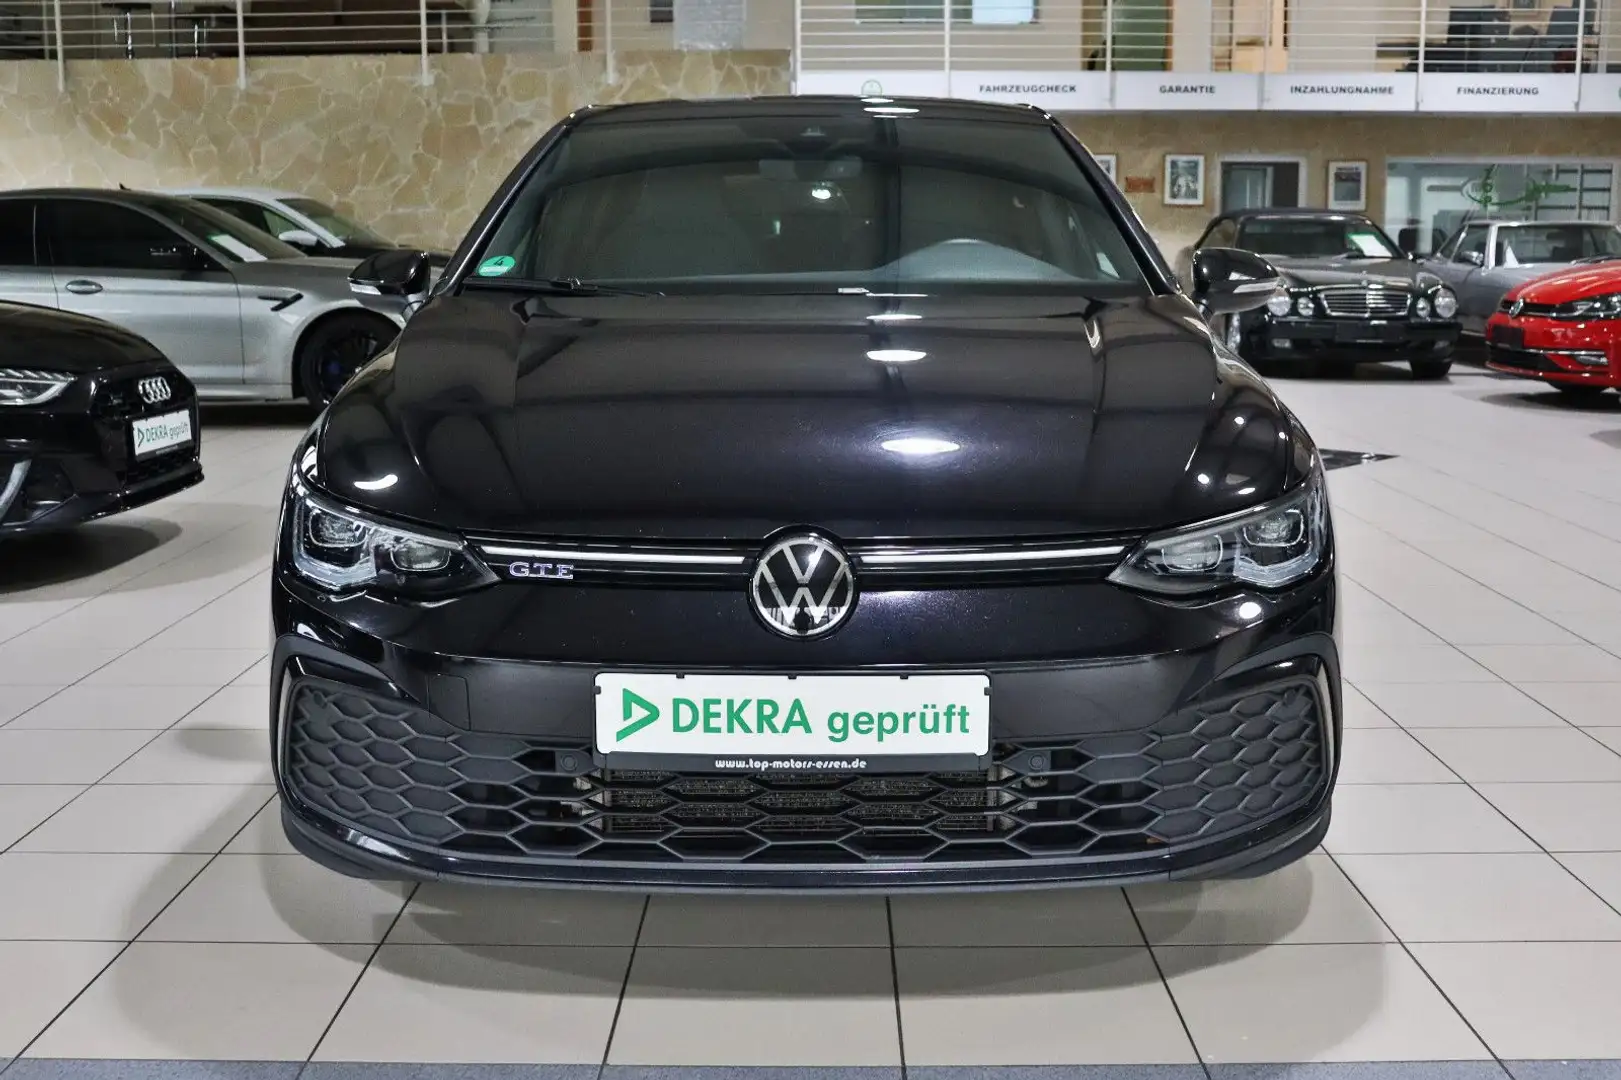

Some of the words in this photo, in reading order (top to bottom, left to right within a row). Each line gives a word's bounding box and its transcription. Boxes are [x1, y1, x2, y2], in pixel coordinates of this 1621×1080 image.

[978, 84, 1077, 94] FAHRZEUGCHECK
[1158, 85, 1216, 94] GARANTIE
[1289, 85, 1395, 95] INZAHLUNGNAHME
[1456, 86, 1540, 96] FINANZIERUNG
[493, 256, 505, 266] 4
[146, 425, 169, 442] DEKRA
[509, 561, 574, 580] GTE
[756, 540, 851, 632] VW
[672, 697, 812, 734] DEKRA
[827, 703, 970, 742] geprüft
[714, 758, 868, 772] www.top-motors-essen.de
